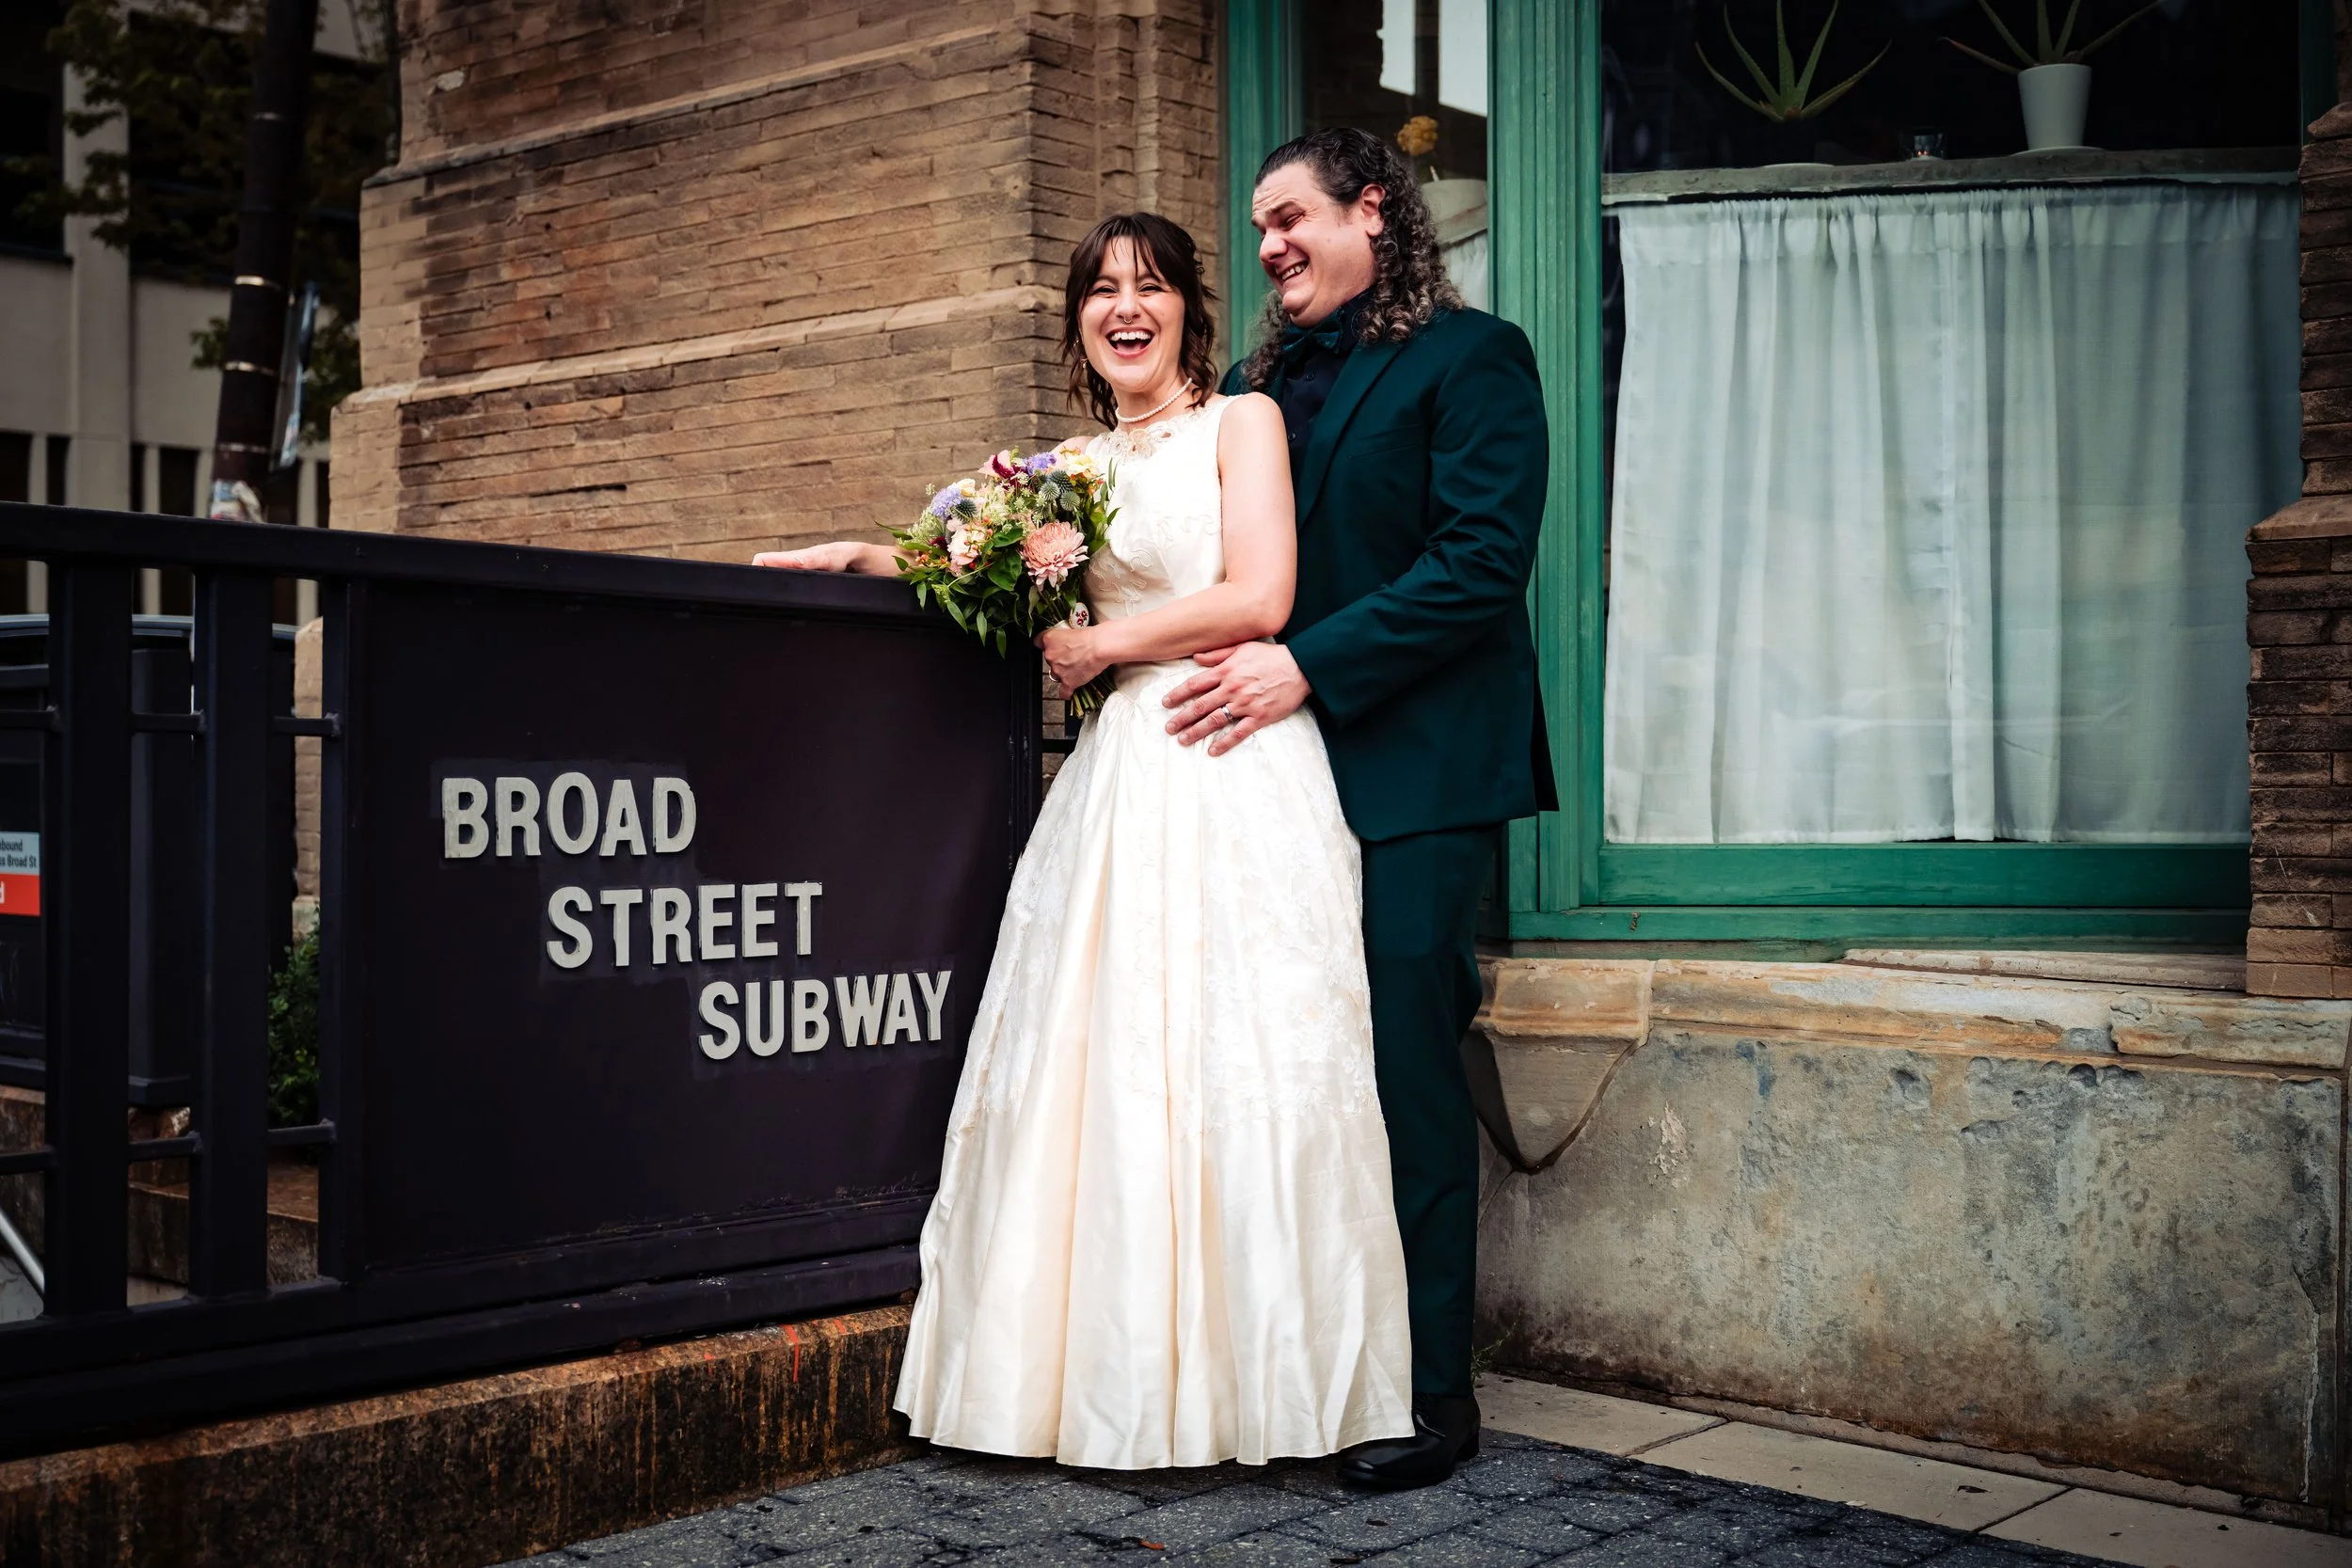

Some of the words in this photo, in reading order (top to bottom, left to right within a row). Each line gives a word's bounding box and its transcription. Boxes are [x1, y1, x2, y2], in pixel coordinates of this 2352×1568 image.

[0, 838, 23, 852] bound
[441, 771, 697, 859] BROAD
[7, 853, 27, 868] Broad
[29, 854, 37, 869] St
[546, 880, 823, 969] STREET
[697, 970, 952, 1061] SUBWAY
